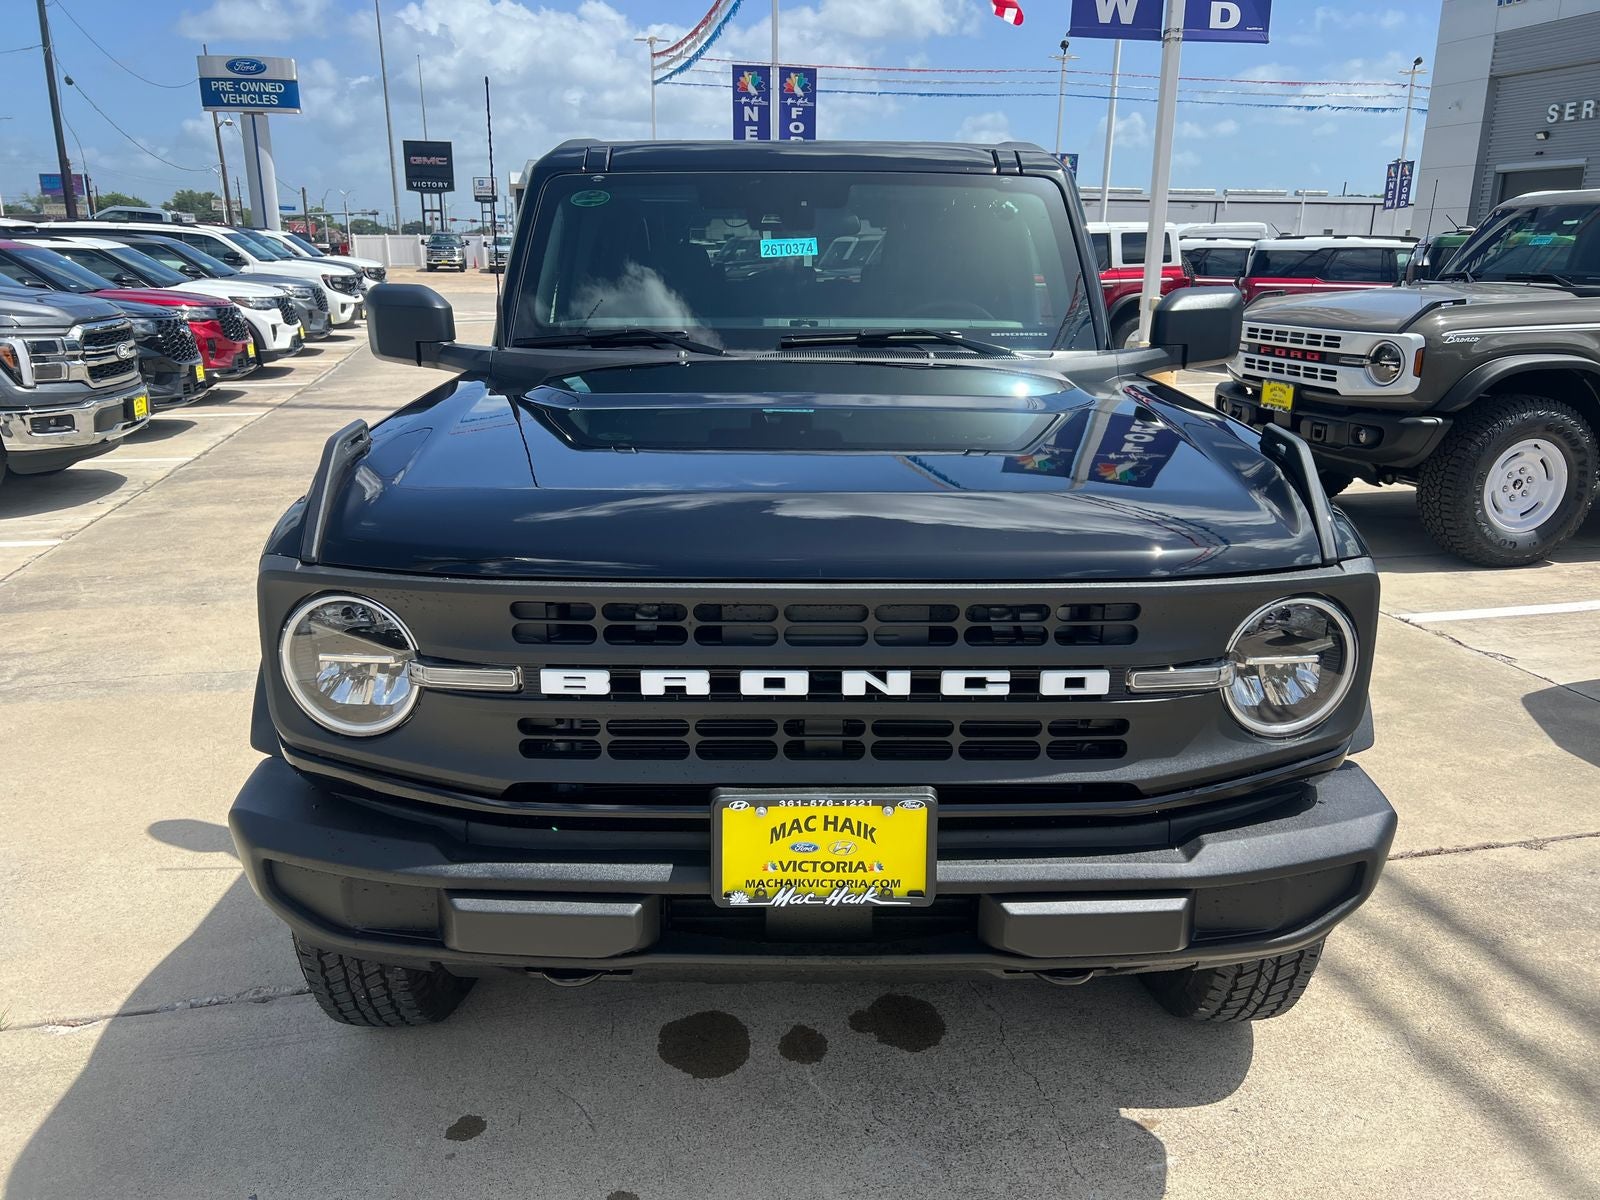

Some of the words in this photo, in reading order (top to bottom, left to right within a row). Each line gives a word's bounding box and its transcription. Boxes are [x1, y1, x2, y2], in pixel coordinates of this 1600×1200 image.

[1209, 1, 1241, 29] D
[233, 61, 258, 71] Ford
[220, 94, 279, 105] VEHICLES
[788, 107, 805, 141] FO
[409, 155, 448, 166] GMC
[412, 181, 449, 189] VICTORY
[1385, 181, 1395, 208] NEW
[1399, 180, 1409, 207] FORD
[763, 242, 814, 256] 26T0374
[1443, 334, 1480, 344] Bronco
[1260, 345, 1321, 361] FORD
[540, 668, 1110, 696] BRONCO
[770, 815, 817, 844] MAC
[823, 815, 877, 845] HAIK
[778, 860, 868, 873] VICTORIA
[745, 878, 901, 889] MACHAIKVICTORIA.COM
[770, 885, 824, 907] Mac
[824, 885, 880, 906] Haik
